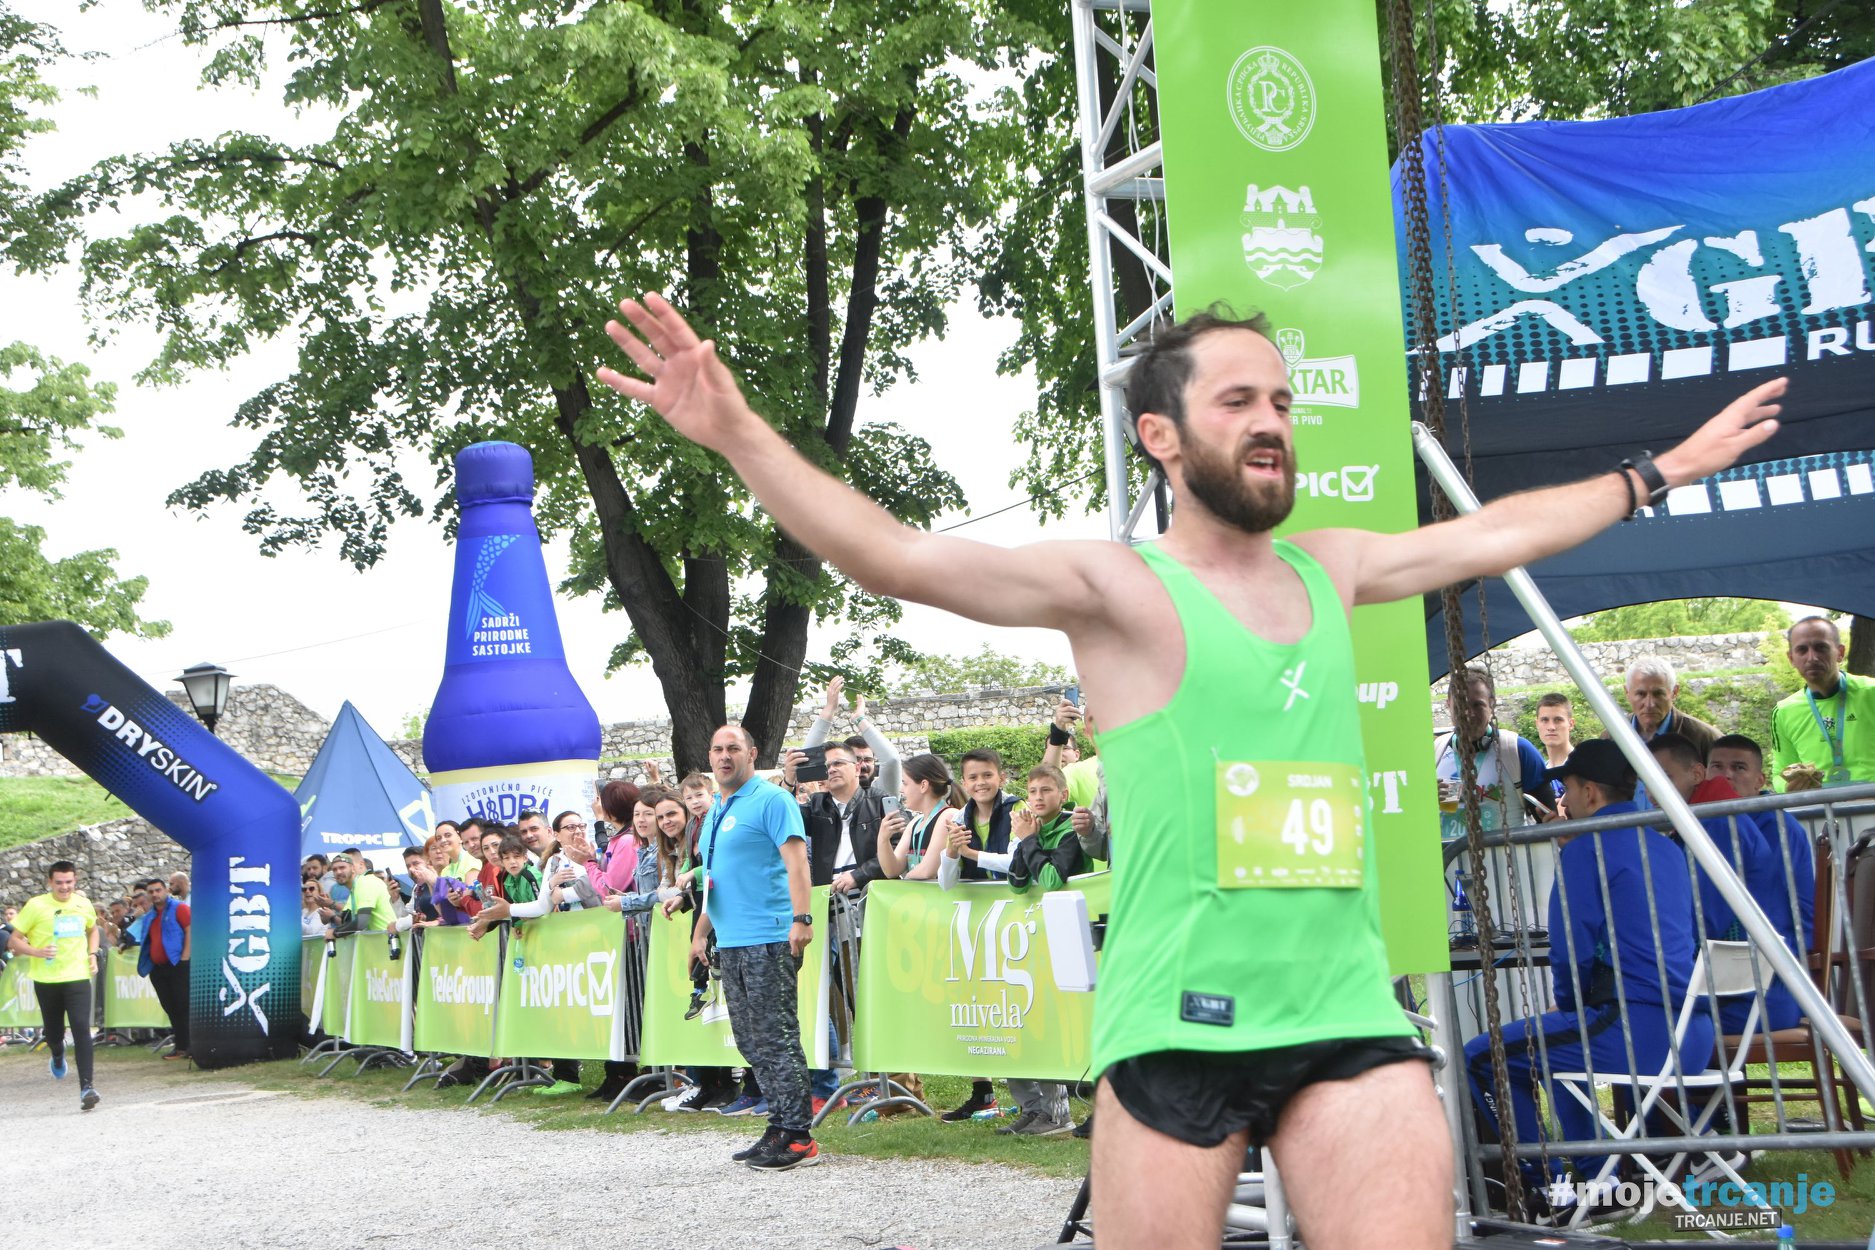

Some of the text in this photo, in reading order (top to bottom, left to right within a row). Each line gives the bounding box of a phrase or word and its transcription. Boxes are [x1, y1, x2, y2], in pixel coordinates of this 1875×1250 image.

[1302, 416, 1323, 425] PIVO
[481, 612, 520, 629] SADRŽI
[472, 642, 532, 657] SASTOJKE
[473, 629, 530, 643] PRIRODNE
[97, 705, 214, 801] DRYSKIN
[320, 831, 382, 846] TROPIC
[1281, 798, 1335, 856] 49
[430, 963, 496, 1016] TeleGroup
[519, 962, 588, 1008] TROPIC
[950, 989, 1024, 1029] mivela
